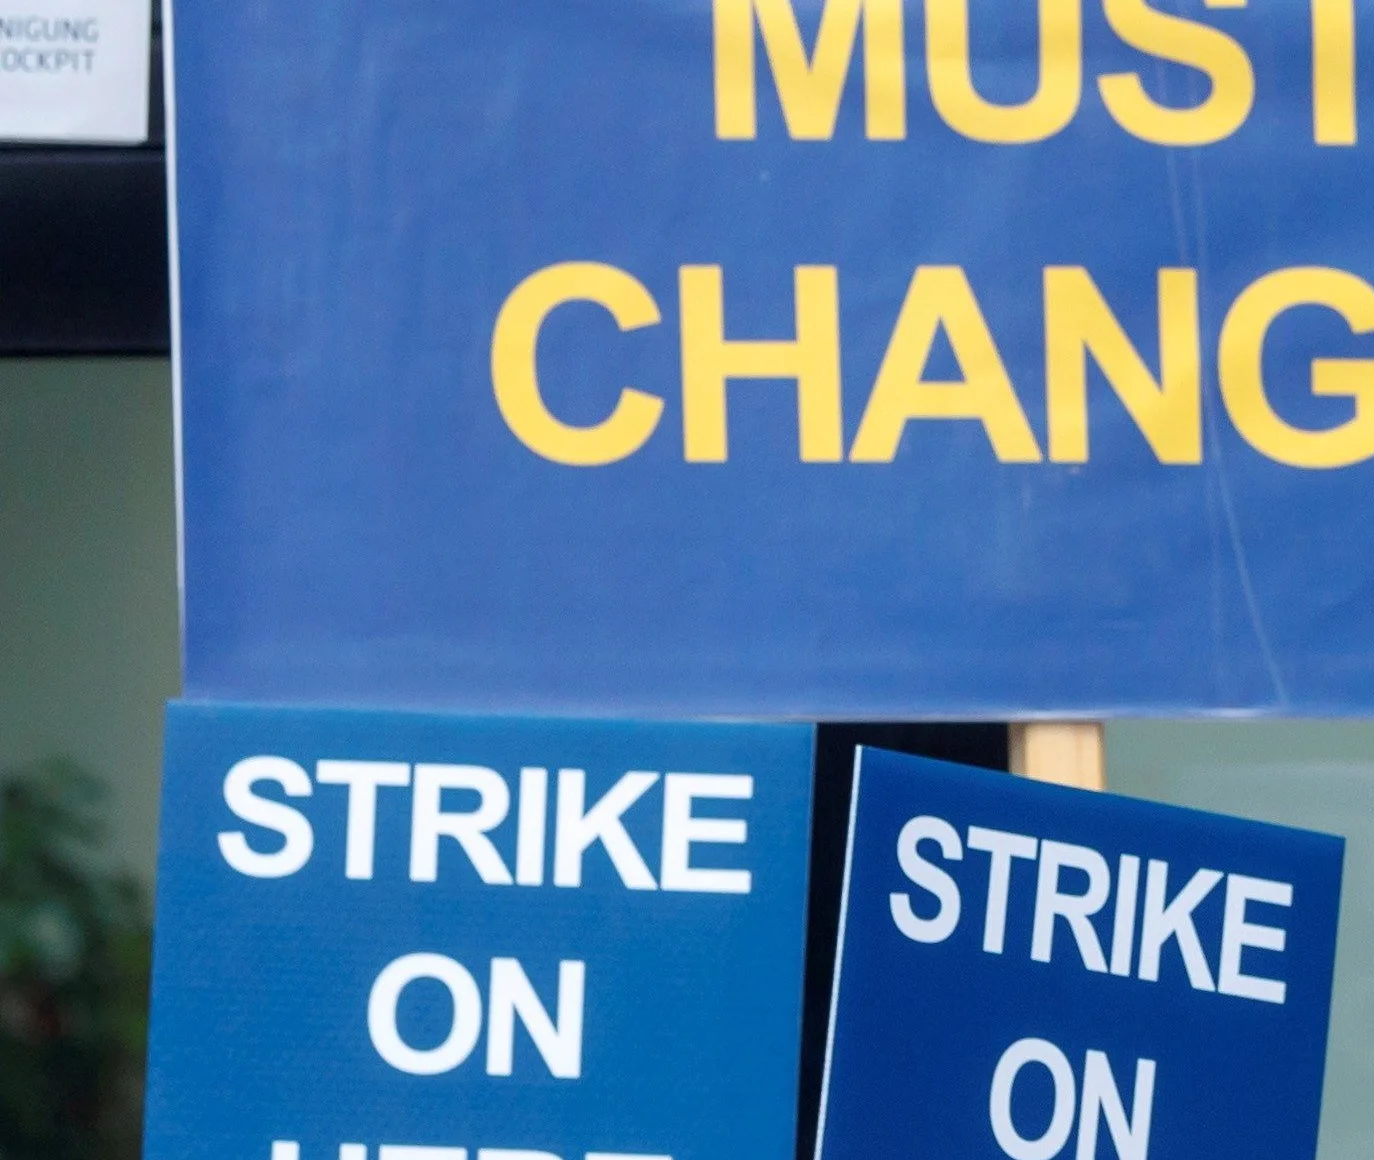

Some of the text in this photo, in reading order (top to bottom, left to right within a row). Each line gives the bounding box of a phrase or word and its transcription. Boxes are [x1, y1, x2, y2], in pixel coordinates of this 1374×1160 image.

[0, 46, 95, 75] OCKPIT
[218, 757, 753, 892] STRIKE
[891, 814, 1293, 1004] STRIKE
[369, 954, 584, 1077] ON
